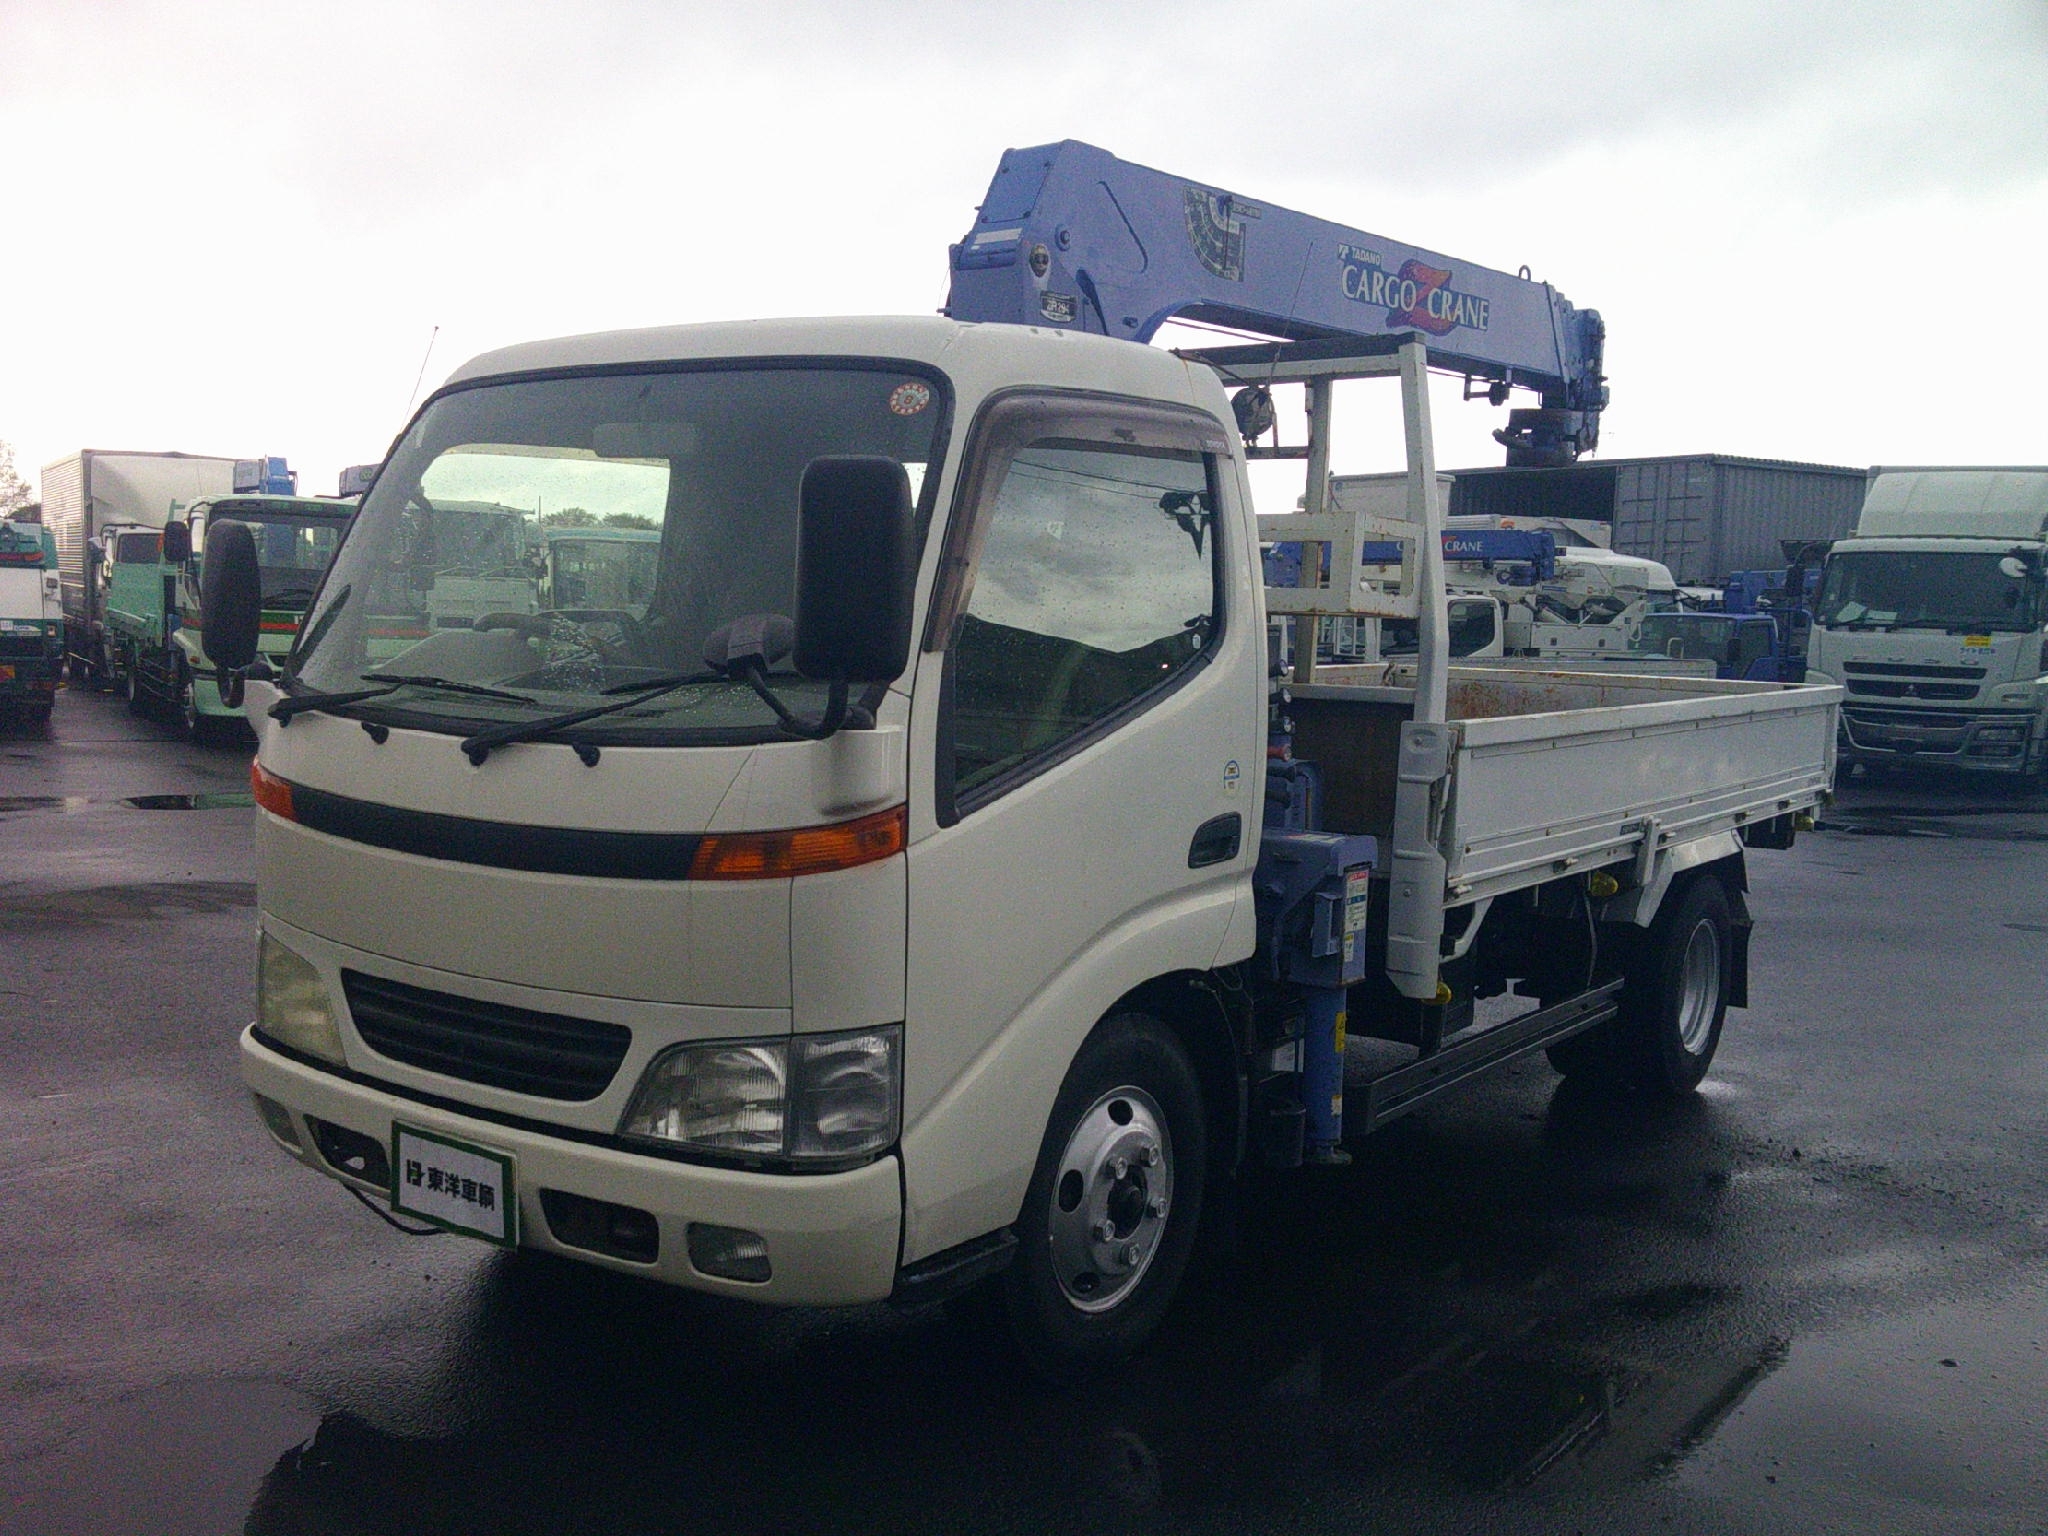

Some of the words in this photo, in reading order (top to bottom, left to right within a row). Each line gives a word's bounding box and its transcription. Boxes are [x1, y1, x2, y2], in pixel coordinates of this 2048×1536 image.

[1351, 246, 1382, 265] TADANO
[1341, 264, 1417, 313] CARGO
[1427, 287, 1490, 331] CRANE
[1444, 540, 1484, 553] CRANE
